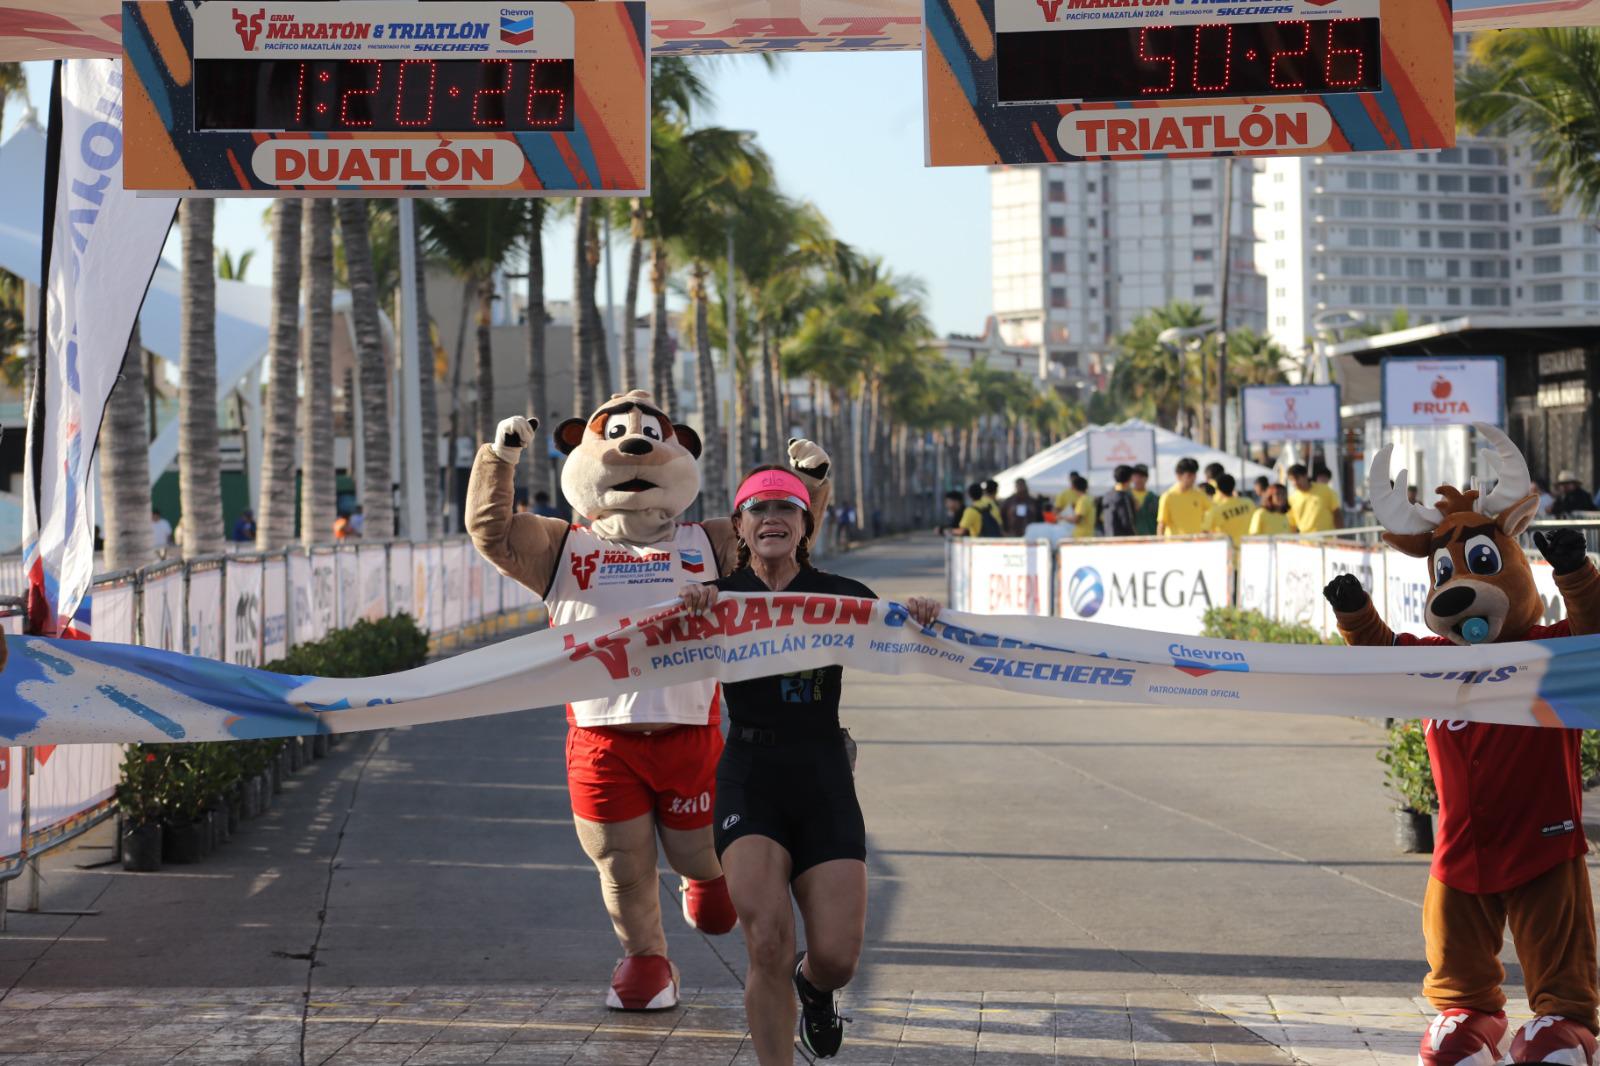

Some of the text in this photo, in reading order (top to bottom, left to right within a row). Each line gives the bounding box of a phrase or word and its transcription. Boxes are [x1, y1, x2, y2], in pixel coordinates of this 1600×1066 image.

[270, 14, 295, 22] GRAN
[1066, 11, 1101, 20] PACÍFICO
[1102, 10, 1144, 19] MAZATLÁN
[1145, 10, 1164, 18] 2024
[1216, 5, 1294, 17] SKECHERS
[266, 21, 490, 39] MARATÓN & TRIATLÓN
[264, 42, 299, 50] PACÍFICO
[300, 42, 341, 50] MAZATLÁN
[413, 43, 490, 51] SKECHERS
[1075, 105, 1308, 152] TRIATLÓN
[274, 139, 494, 181] DUATLÓN
[1412, 401, 1470, 414] FRUTA
[1109, 569, 1213, 608] MEGA
[652, 645, 722, 669] PACÍFICO
[811, 634, 855, 649] 2024
[940, 651, 966, 664] POR
[969, 654, 1137, 687] SKECHERS
[1168, 642, 1246, 663] Chevron
[814, 668, 826, 701] SPOR
[1148, 685, 1241, 699] PATROCINADOR OFICIAL
